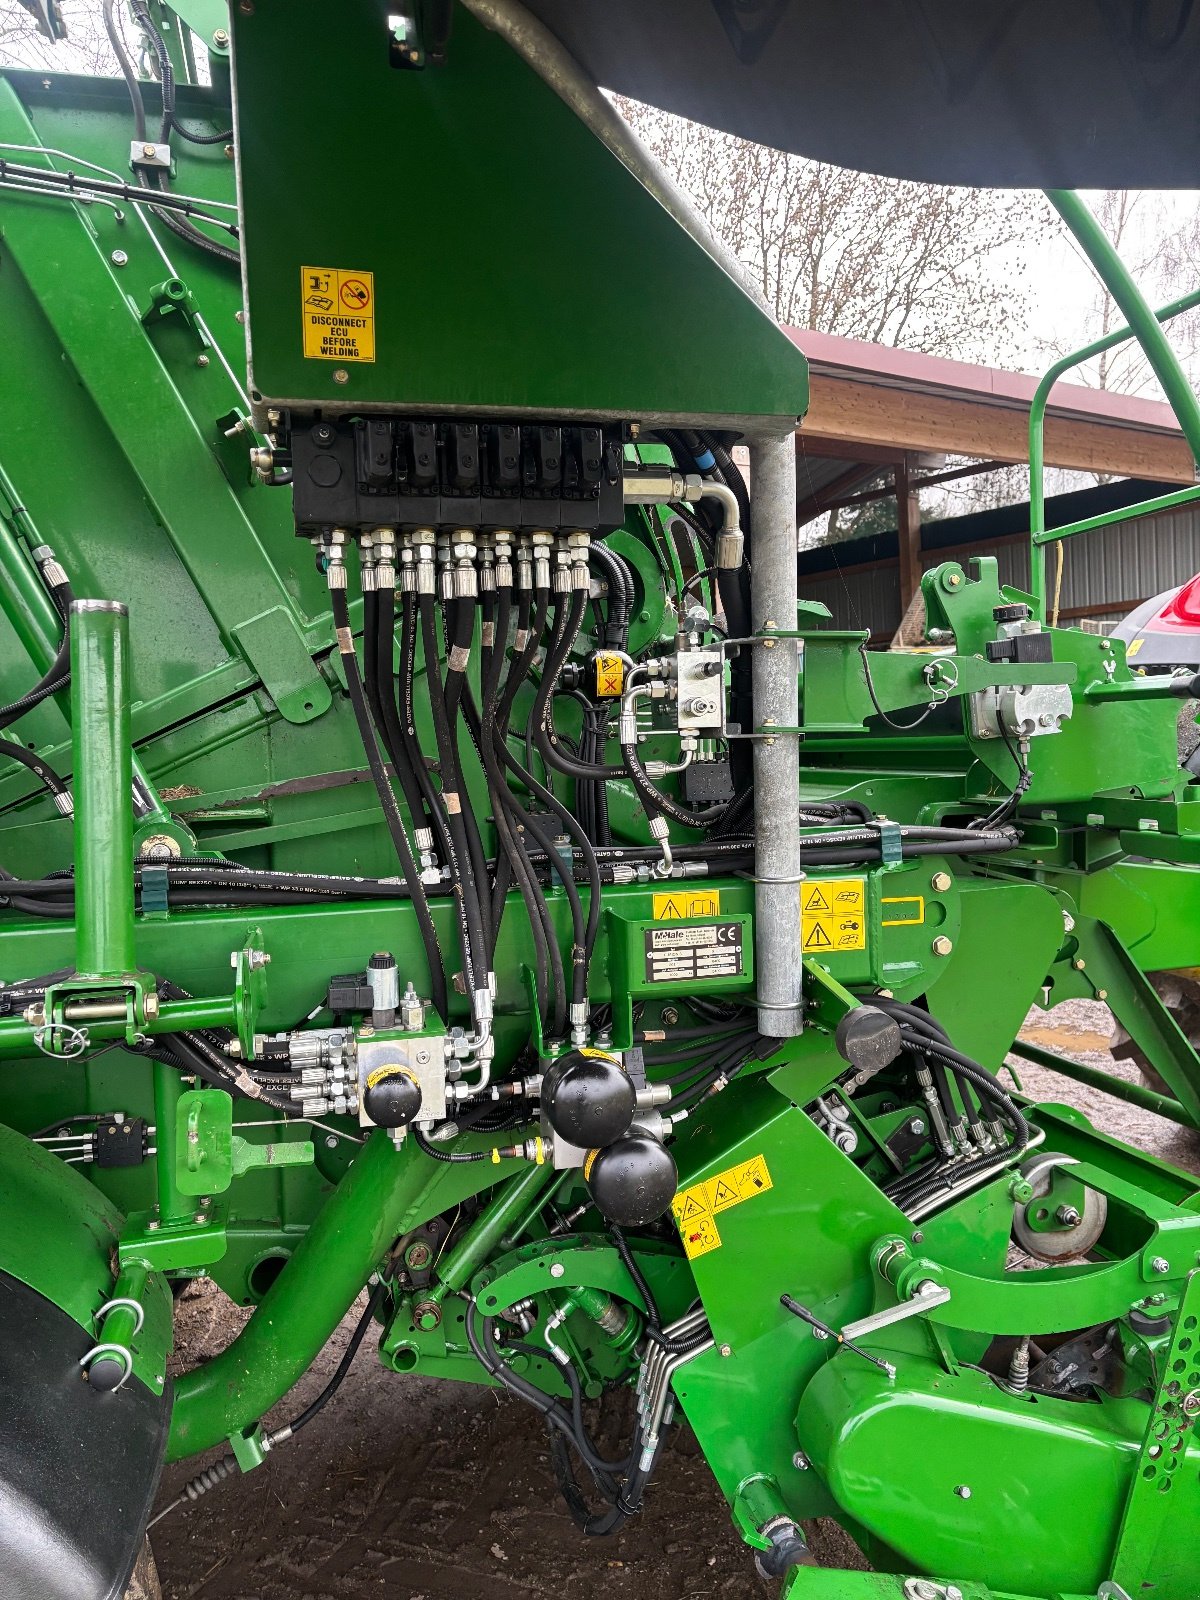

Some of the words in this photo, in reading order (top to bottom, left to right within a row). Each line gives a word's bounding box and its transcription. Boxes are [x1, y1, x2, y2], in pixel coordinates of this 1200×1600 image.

[311, 316, 366, 328] DISCONNECT
[330, 327, 348, 336] ECU
[322, 336, 356, 347] BEFORE
[320, 346, 360, 357] WELDING
[630, 756, 640, 772] MPa
[646, 788, 658, 798] WP
[718, 926, 736, 941] CE
[226, 1067, 236, 1077] WP
